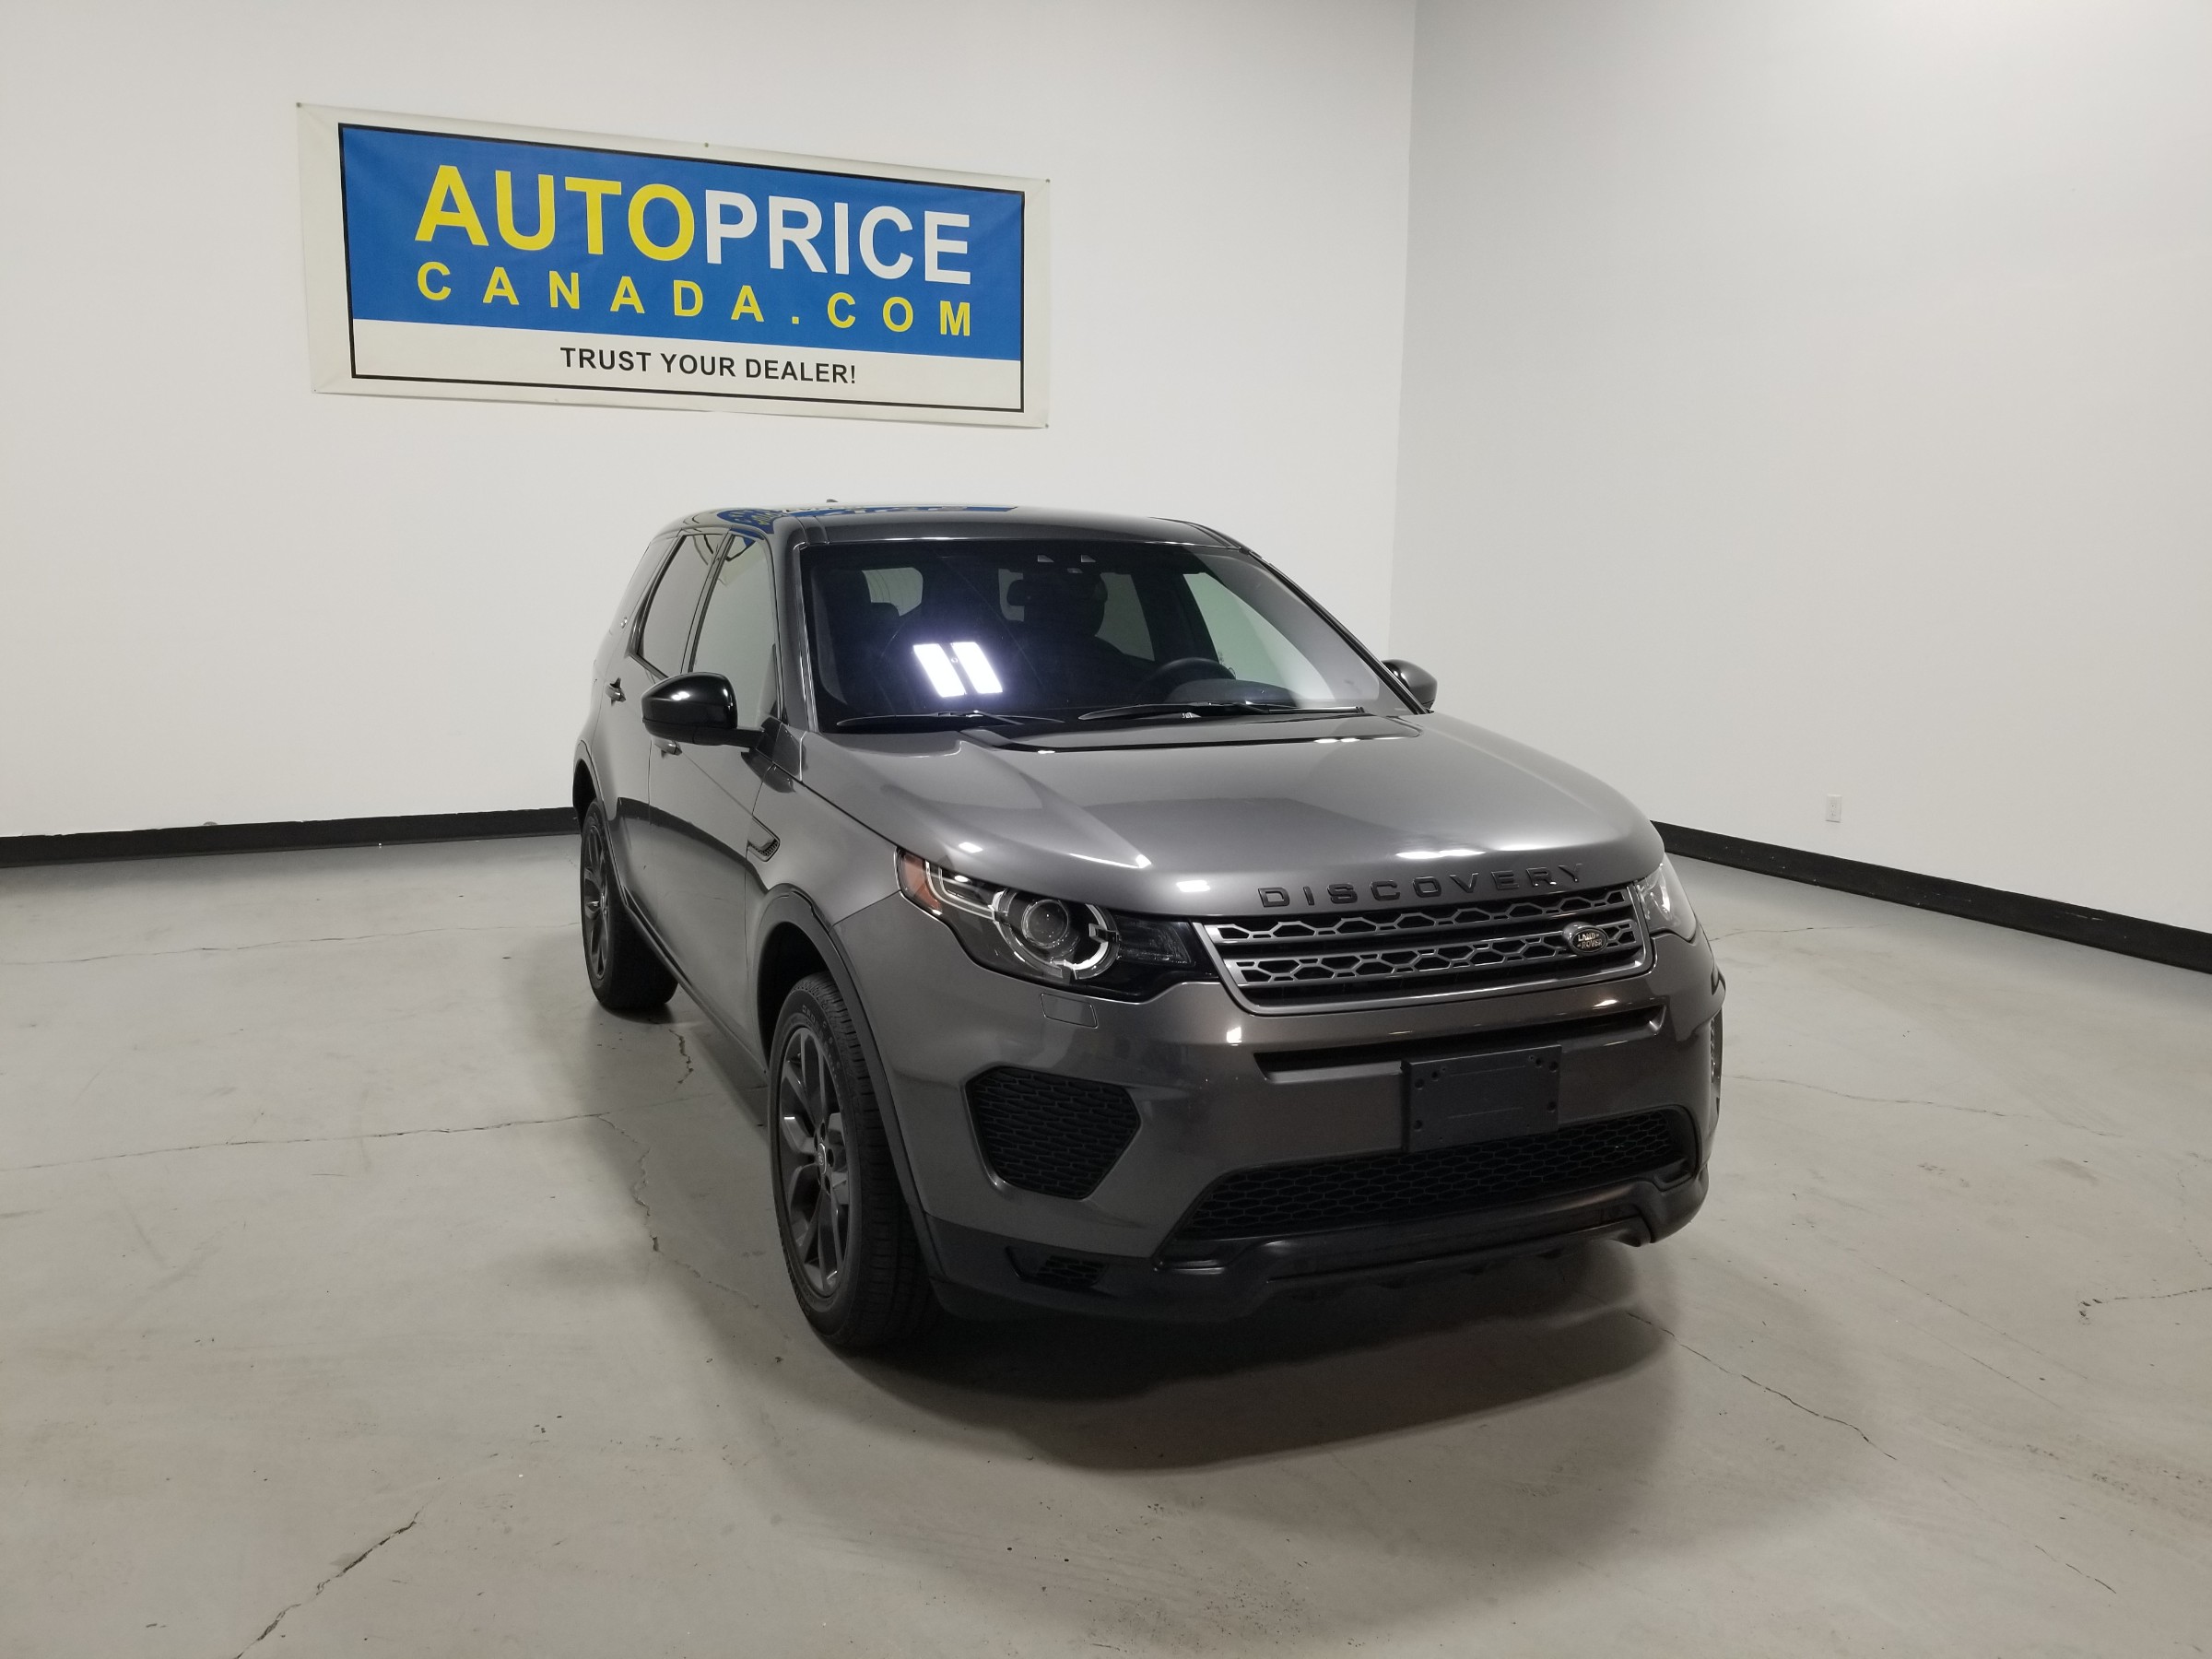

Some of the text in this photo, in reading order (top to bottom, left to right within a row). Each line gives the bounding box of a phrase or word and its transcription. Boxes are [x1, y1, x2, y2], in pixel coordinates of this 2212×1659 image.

[416, 164, 971, 285] AUTOPRICE
[418, 262, 970, 335] CANADA.COM
[559, 347, 856, 384] TRUST YOUR DEALER!
[1257, 864, 1583, 908] DISCOVERY
[1578, 932, 1596, 942] LAND
[1581, 938, 1603, 949] ROVER
